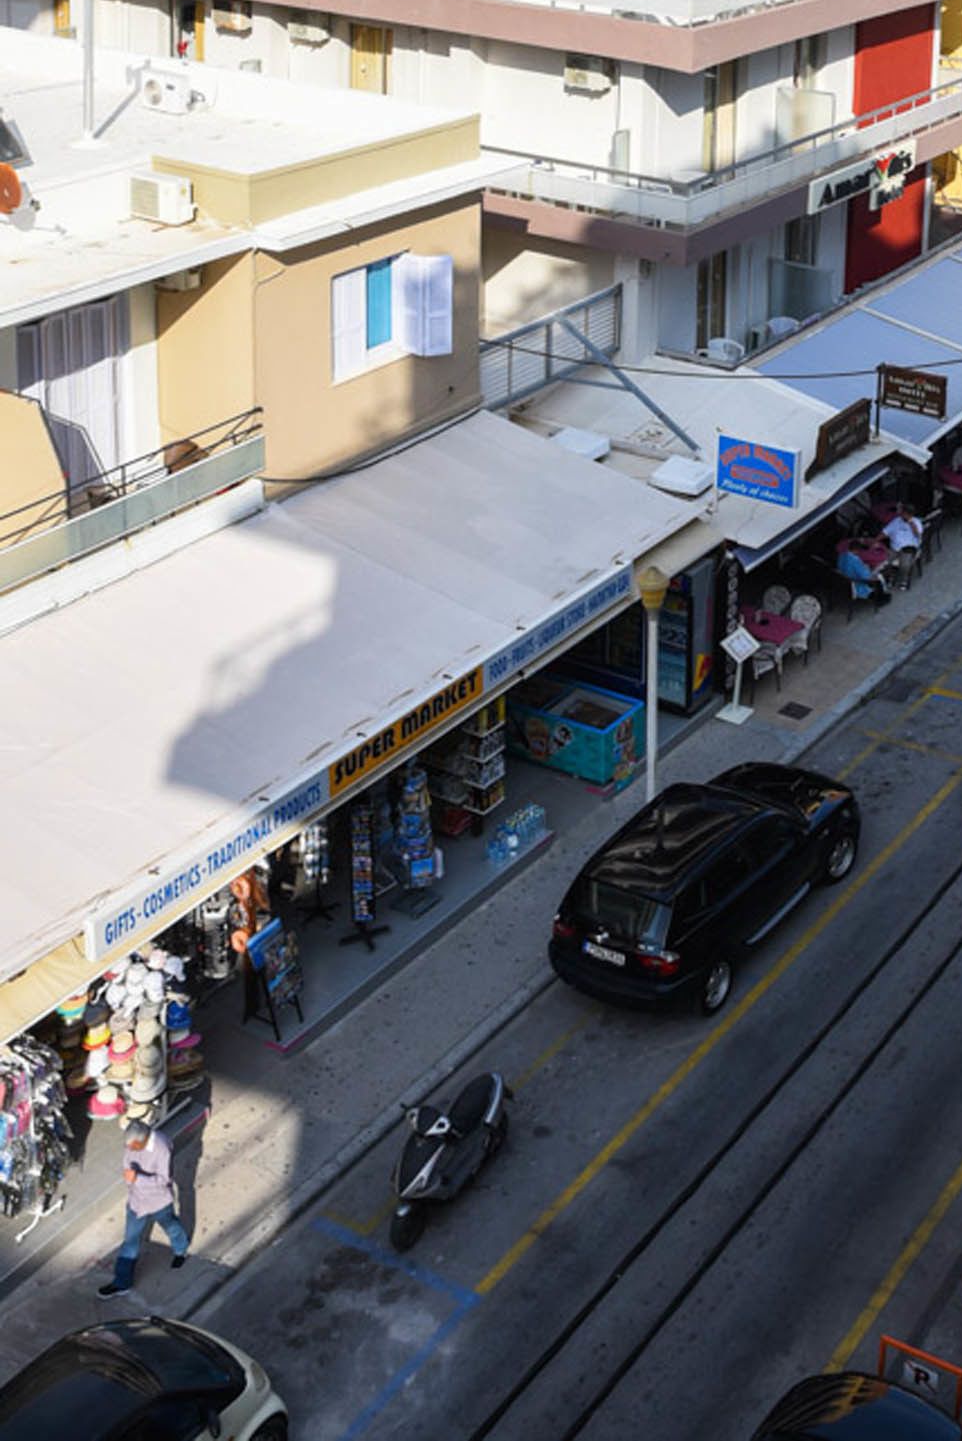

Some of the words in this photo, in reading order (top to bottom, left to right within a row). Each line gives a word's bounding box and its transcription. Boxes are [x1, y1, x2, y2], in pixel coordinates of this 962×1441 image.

[334, 727, 395, 785] SUPER
[401, 670, 478, 739] MARKET
[104, 907, 136, 945] GIFTS
[143, 863, 202, 919] COSMETICS
[207, 816, 272, 875] TRADITIONAL
[274, 781, 321, 829] PRODUCTS
